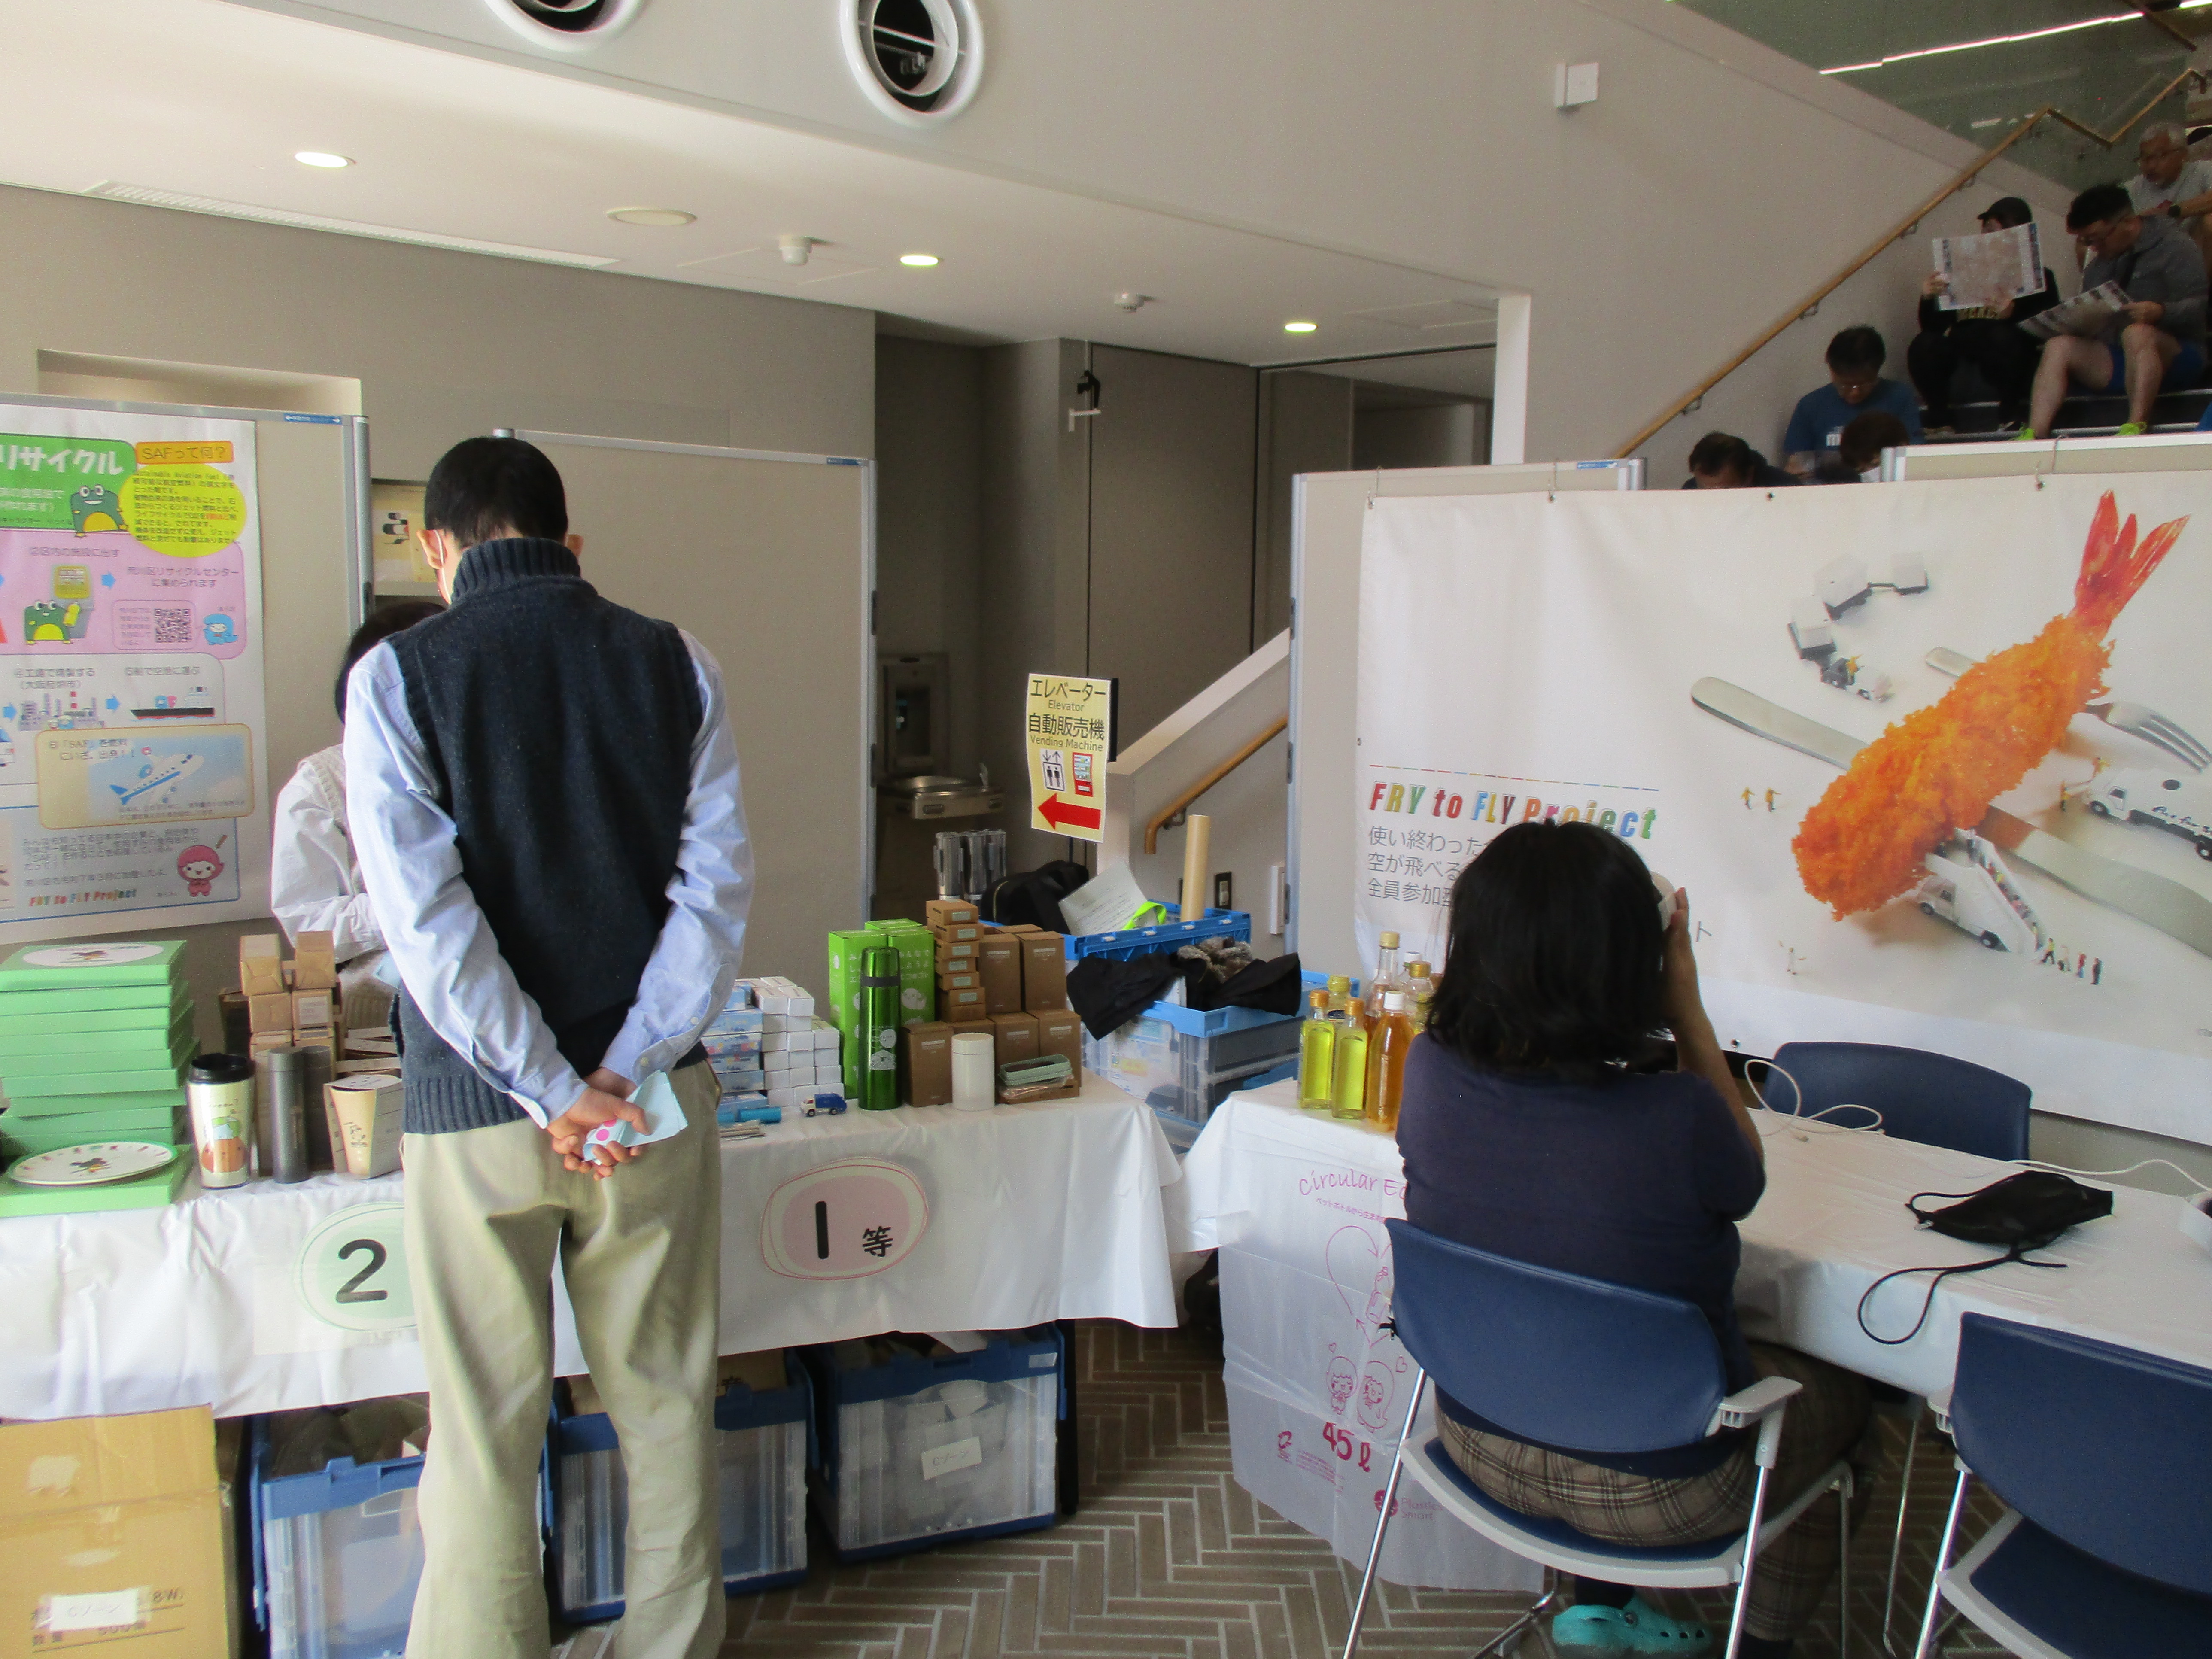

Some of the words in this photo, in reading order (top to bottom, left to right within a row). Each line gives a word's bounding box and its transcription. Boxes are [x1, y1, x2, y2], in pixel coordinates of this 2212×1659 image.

[1030, 679, 1106, 702] エレベーター
[1048, 699, 1085, 712] Elevator
[1029, 713, 1105, 741] 自動販売機
[1030, 735, 1064, 748] Vending
[1065, 738, 1104, 753] Machine
[1368, 781, 1426, 815] FRY
[1431, 787, 1463, 819] to
[1471, 790, 1516, 825] FLY
[1369, 825, 1491, 856] 使い終わった
[1299, 1168, 1378, 1196] Circular
[335, 1238, 388, 1304] 2
